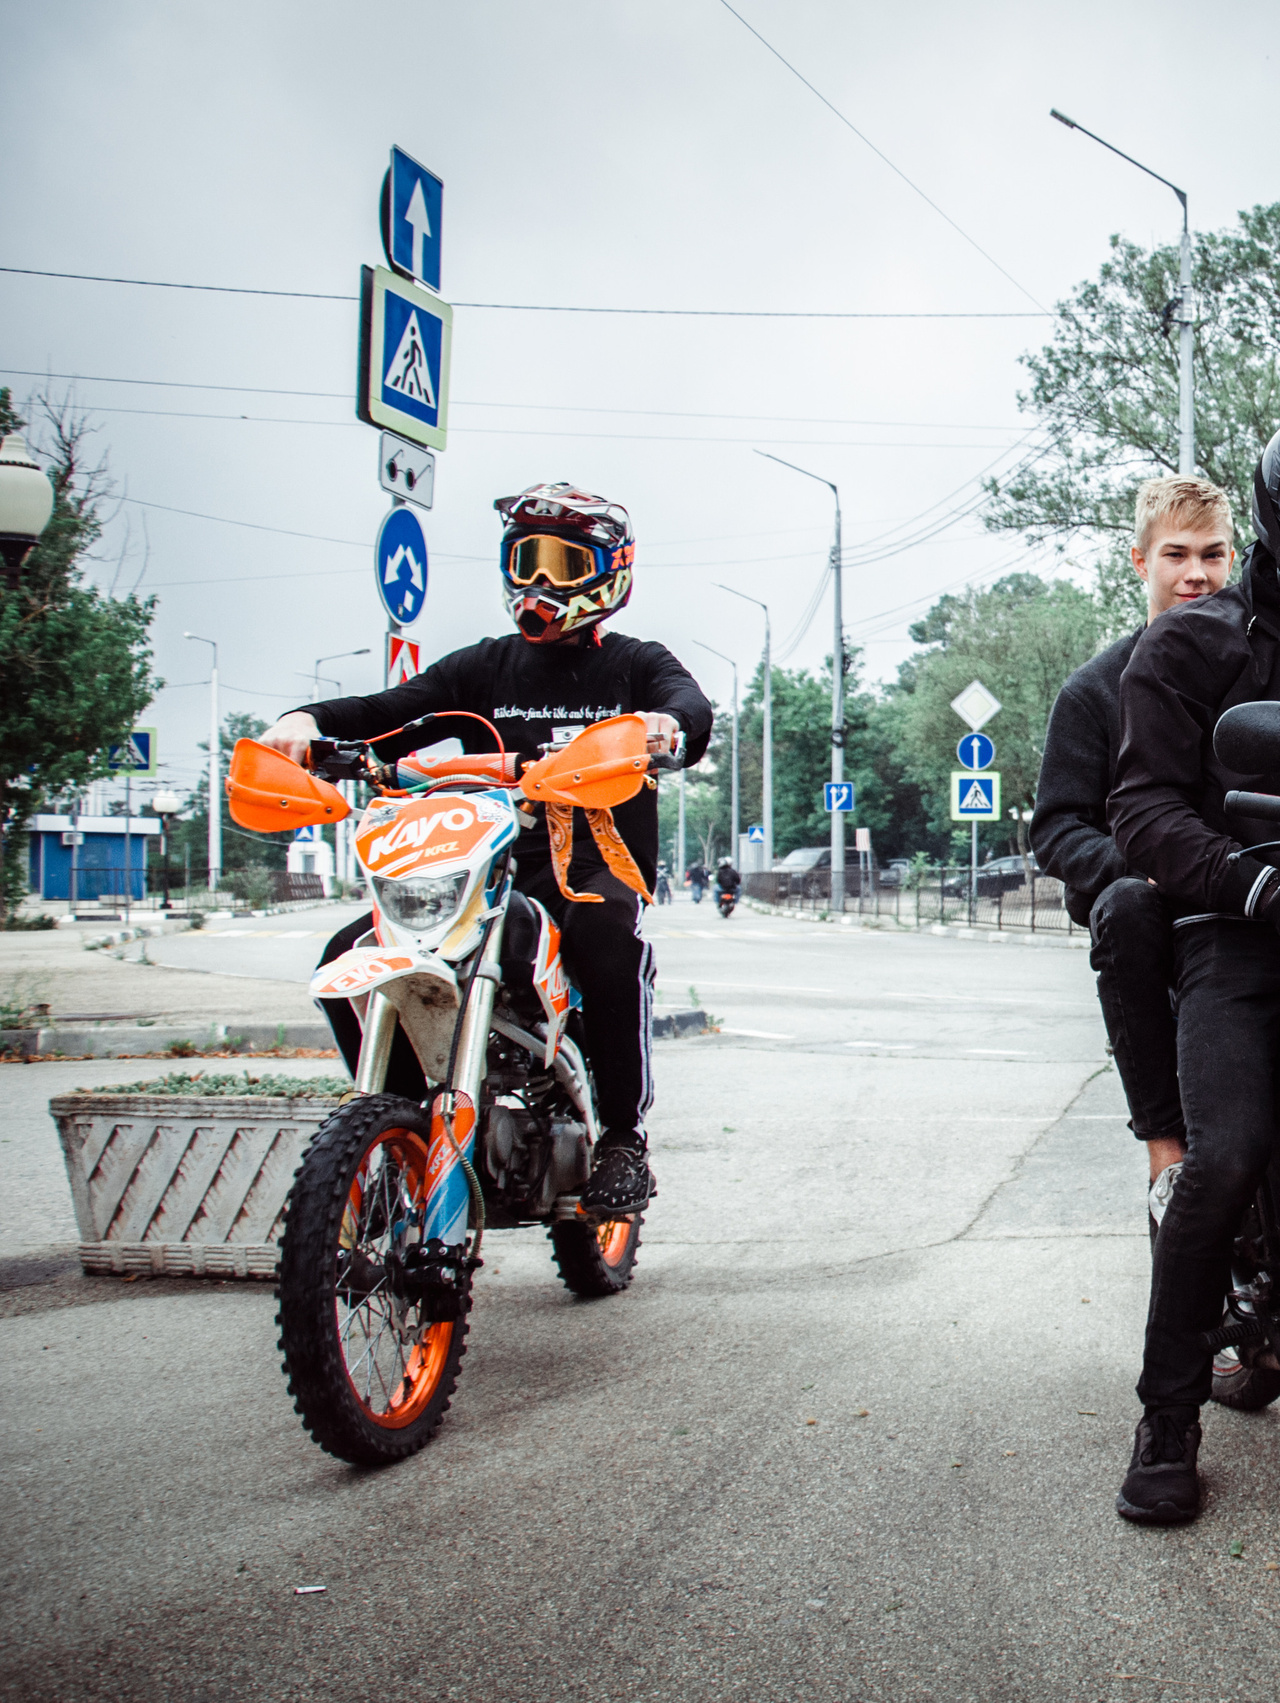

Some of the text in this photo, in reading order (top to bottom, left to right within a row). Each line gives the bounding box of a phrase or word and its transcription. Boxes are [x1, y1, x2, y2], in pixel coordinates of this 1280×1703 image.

[585, 704, 594, 719] be
[367, 808, 474, 865] KAYO
[424, 841, 460, 858] KRZ
[329, 960, 393, 992] EVO
